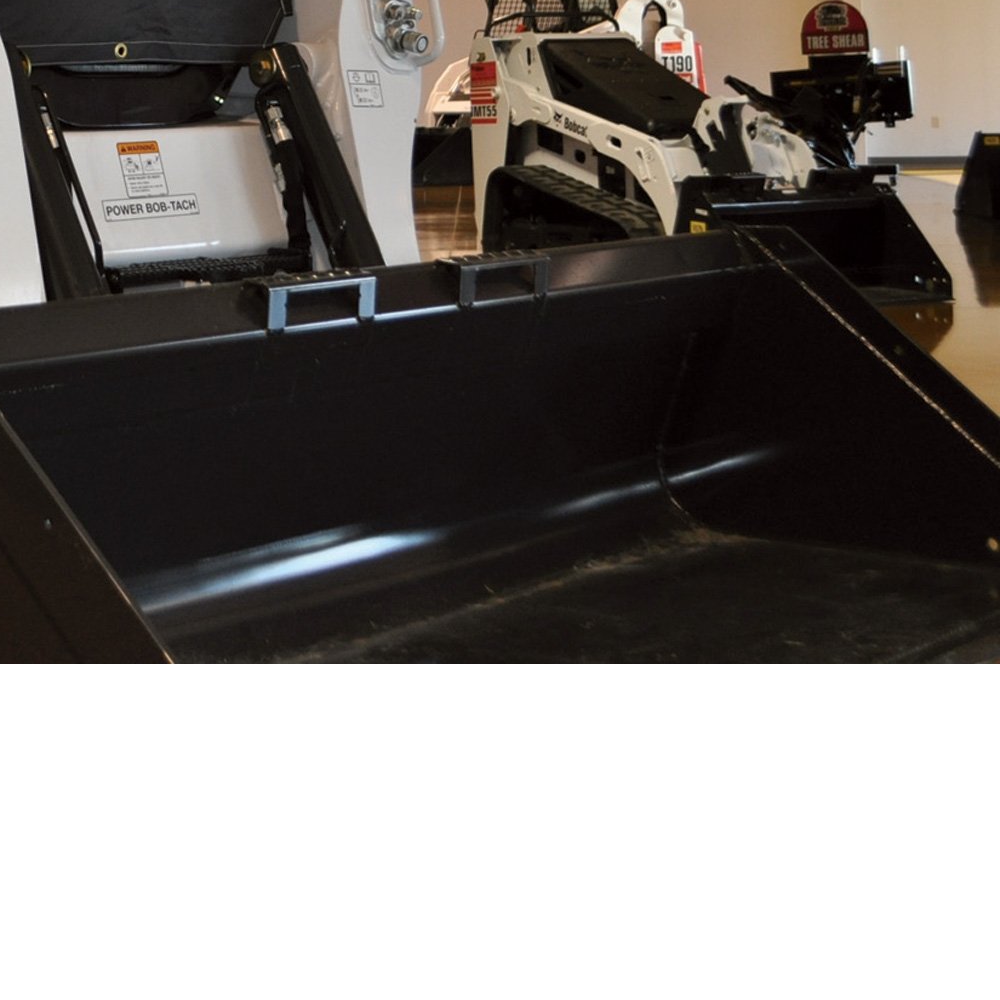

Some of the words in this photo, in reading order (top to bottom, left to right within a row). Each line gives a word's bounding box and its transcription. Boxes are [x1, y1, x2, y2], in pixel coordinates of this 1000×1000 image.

[806, 35, 830, 50] TREE
[831, 33, 865, 49] SHEAR
[661, 55, 693, 73] T190
[564, 116, 588, 138] Bobcat
[126, 144, 156, 152] WARNING
[105, 202, 144, 217] POWER
[145, 199, 197, 214] BOB-TACH
